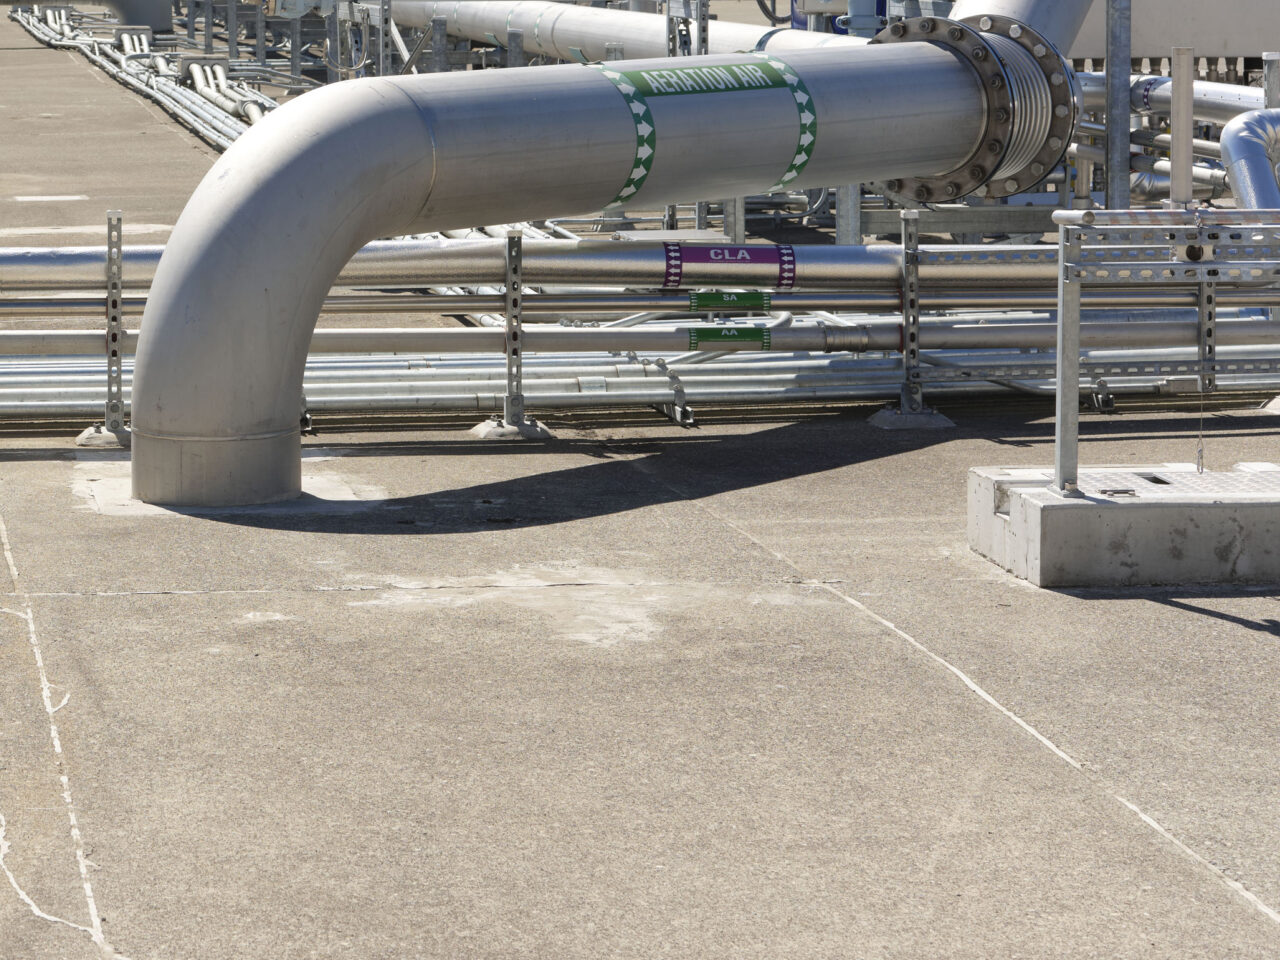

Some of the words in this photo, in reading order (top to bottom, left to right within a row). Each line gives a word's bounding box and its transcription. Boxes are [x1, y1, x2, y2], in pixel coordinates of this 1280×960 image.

[640, 66, 739, 93] AERATION
[732, 64, 772, 88] AIR
[709, 249, 751, 260] CLA
